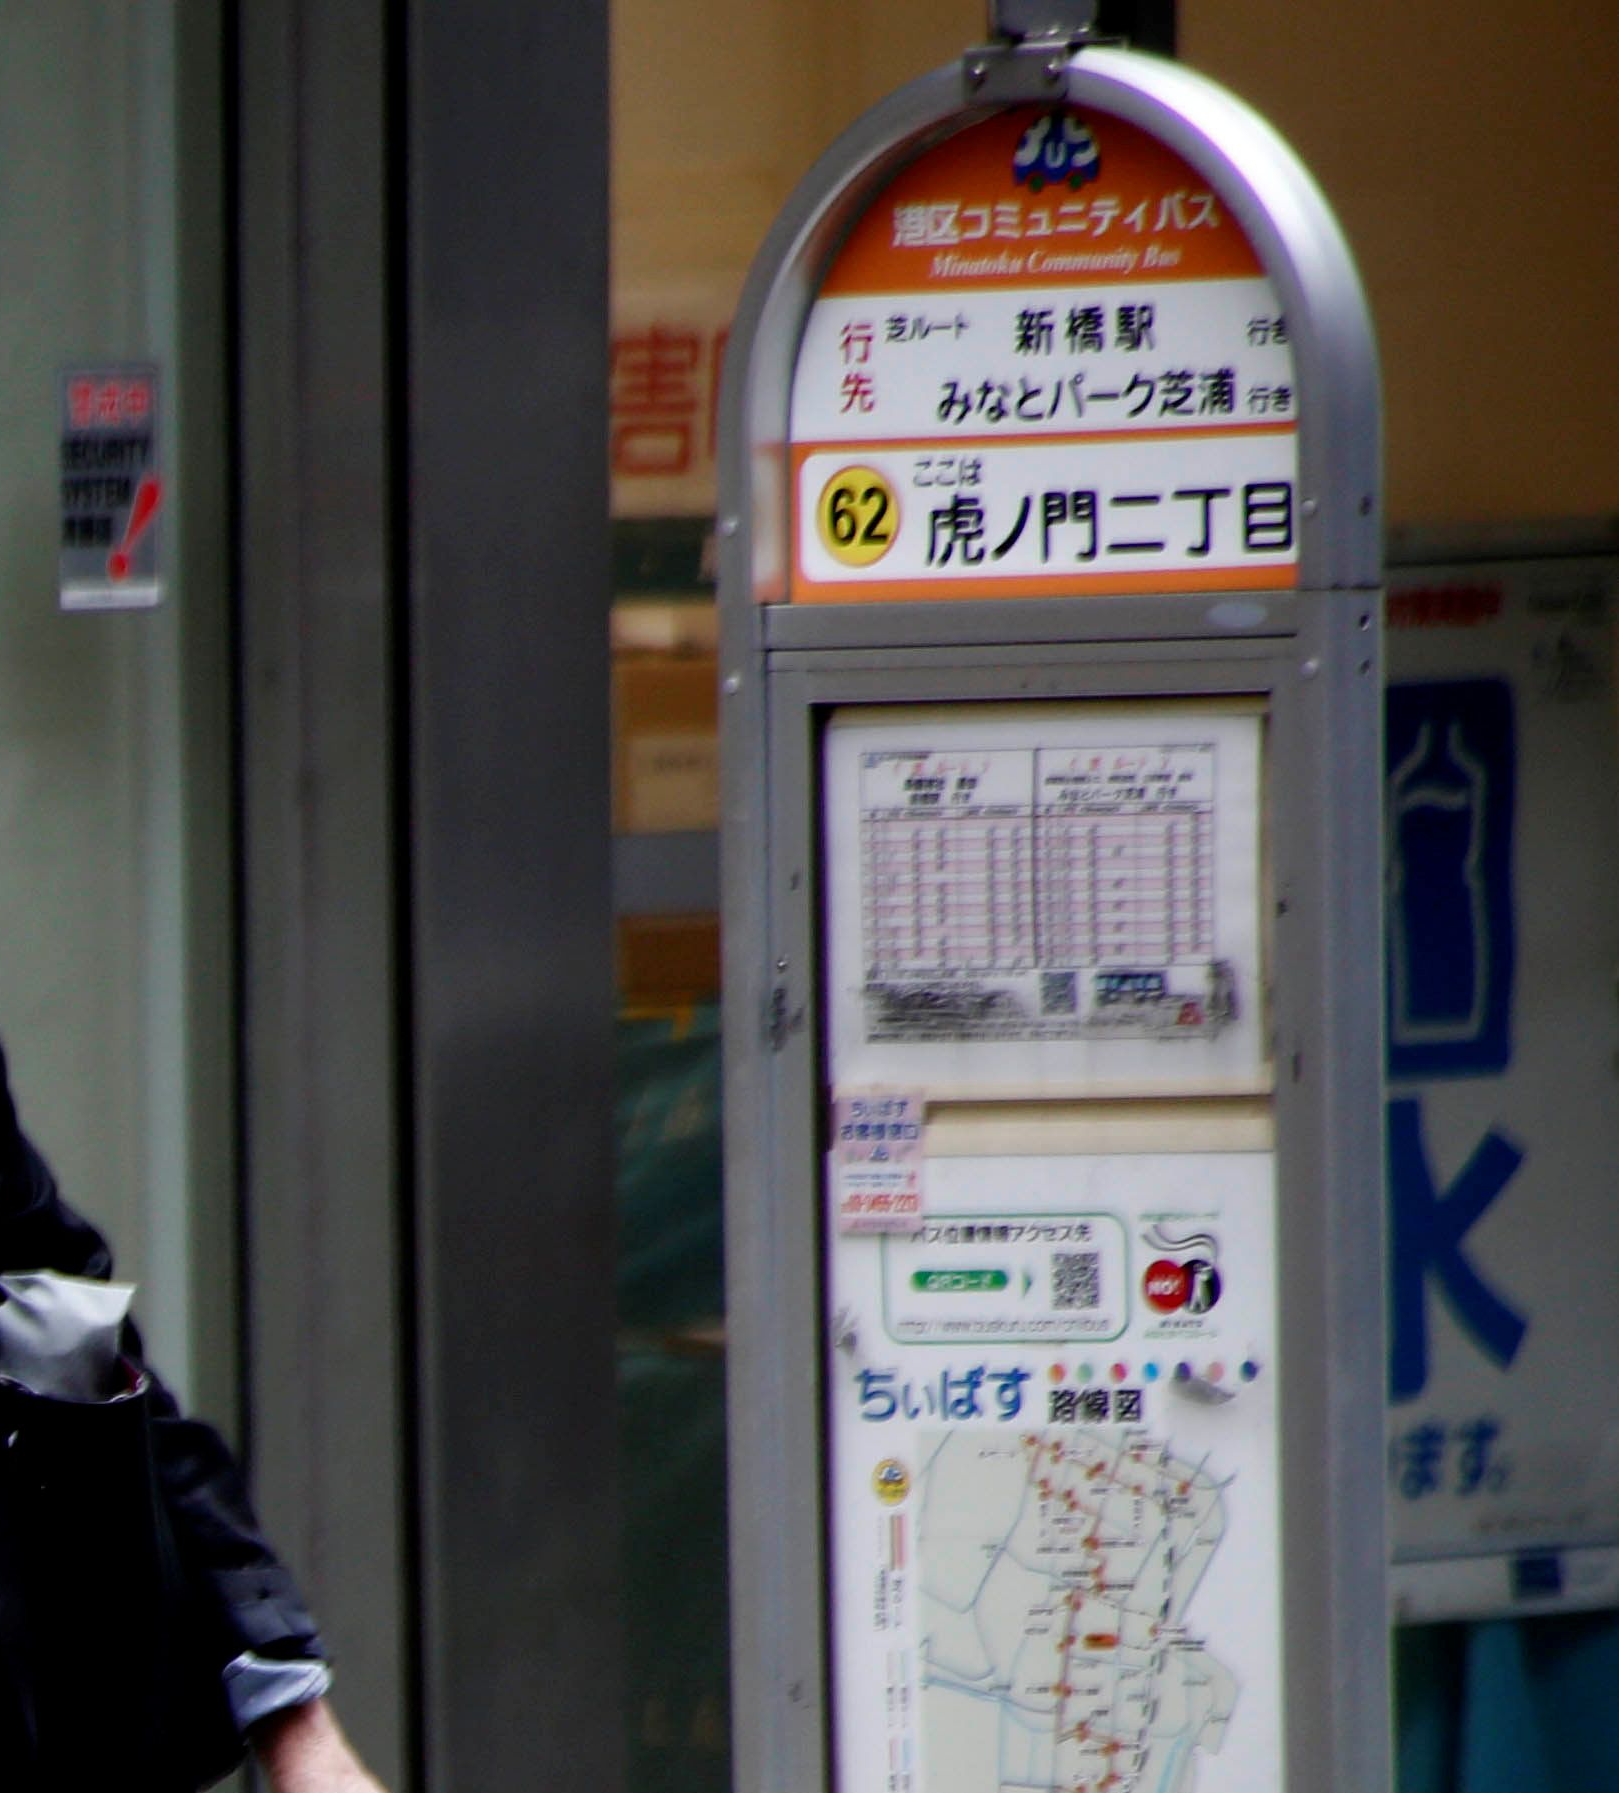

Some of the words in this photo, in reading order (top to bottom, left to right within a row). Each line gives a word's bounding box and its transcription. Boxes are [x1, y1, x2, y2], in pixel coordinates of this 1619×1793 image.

[891, 192, 1222, 249] 港区コミュニティバス
[929, 250, 1021, 278] Minatoku
[1027, 247, 1140, 276] Community
[1144, 244, 1181, 270] Bus
[884, 316, 970, 344] 芝ルート
[1014, 303, 1156, 356] 新橋駅
[937, 366, 1237, 425] みなとパーク芝浦
[1247, 385, 1292, 414] 行き
[913, 457, 983, 488] ここは
[828, 485, 889, 548] 62
[925, 480, 1294, 568] 虎ノ門二丁目
[855, 1364, 1031, 1422] ちいばす
